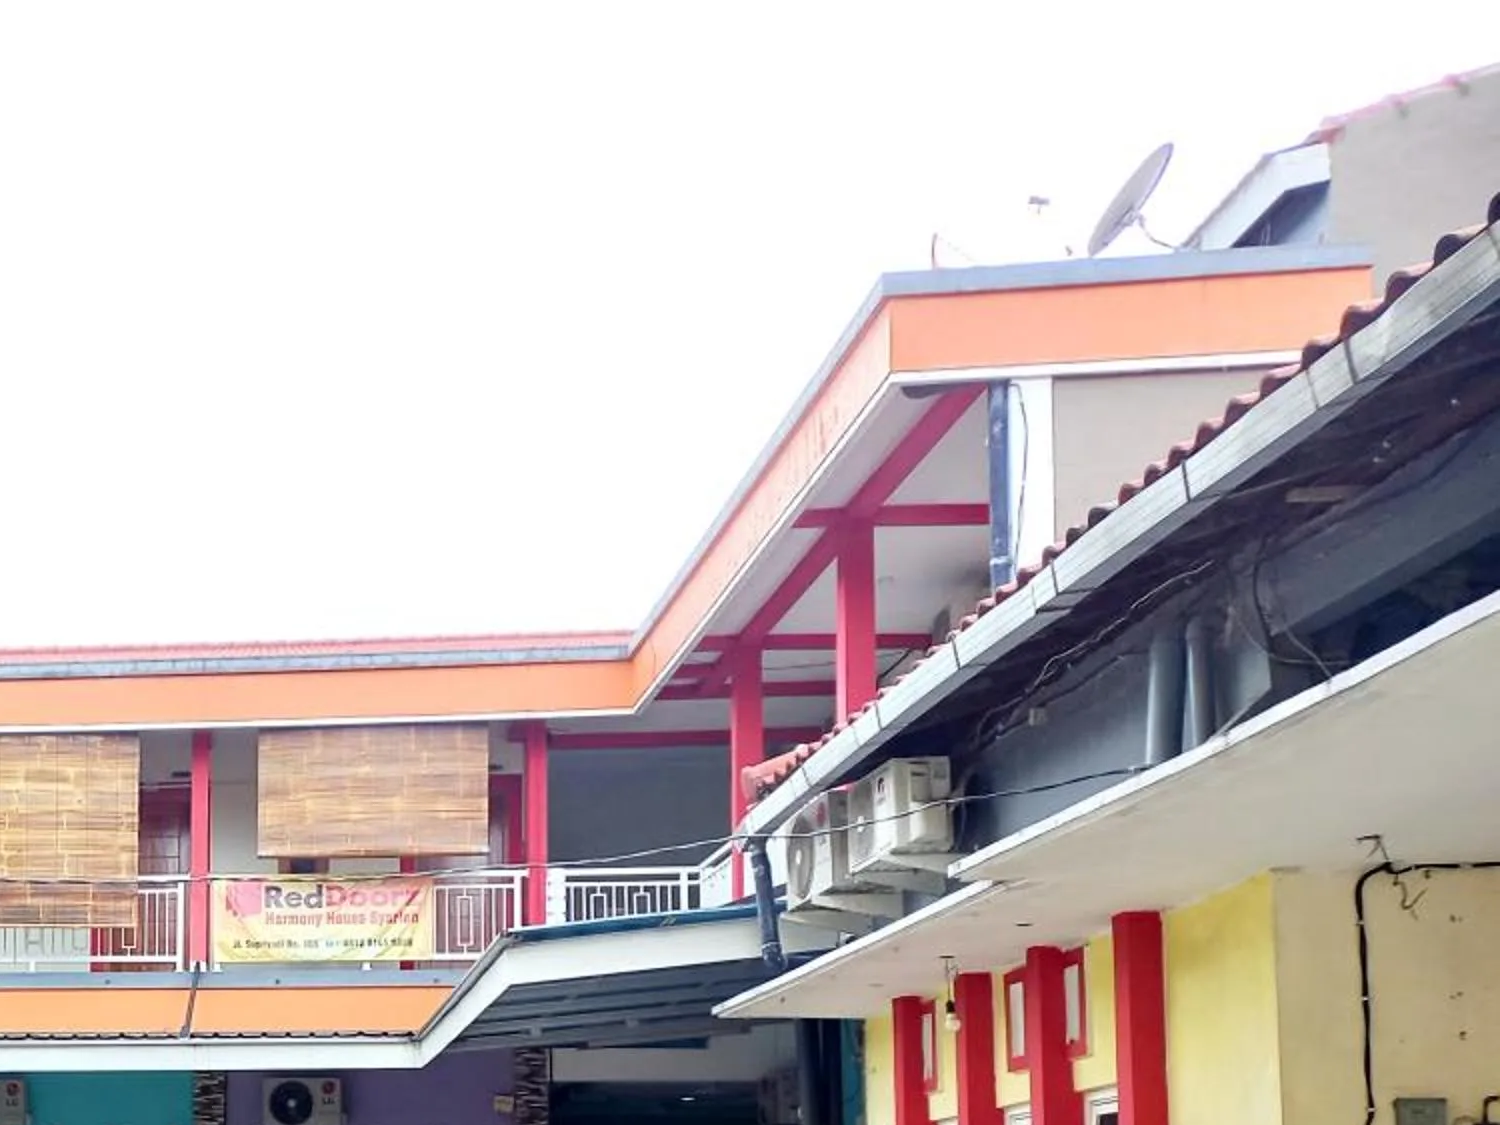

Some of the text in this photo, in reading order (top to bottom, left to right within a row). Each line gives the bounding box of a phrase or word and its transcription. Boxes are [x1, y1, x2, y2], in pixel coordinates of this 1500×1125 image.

[264, 884, 420, 909] RedDoorz
[265, 912, 323, 928] Harmony
[326, 912, 366, 925] House
